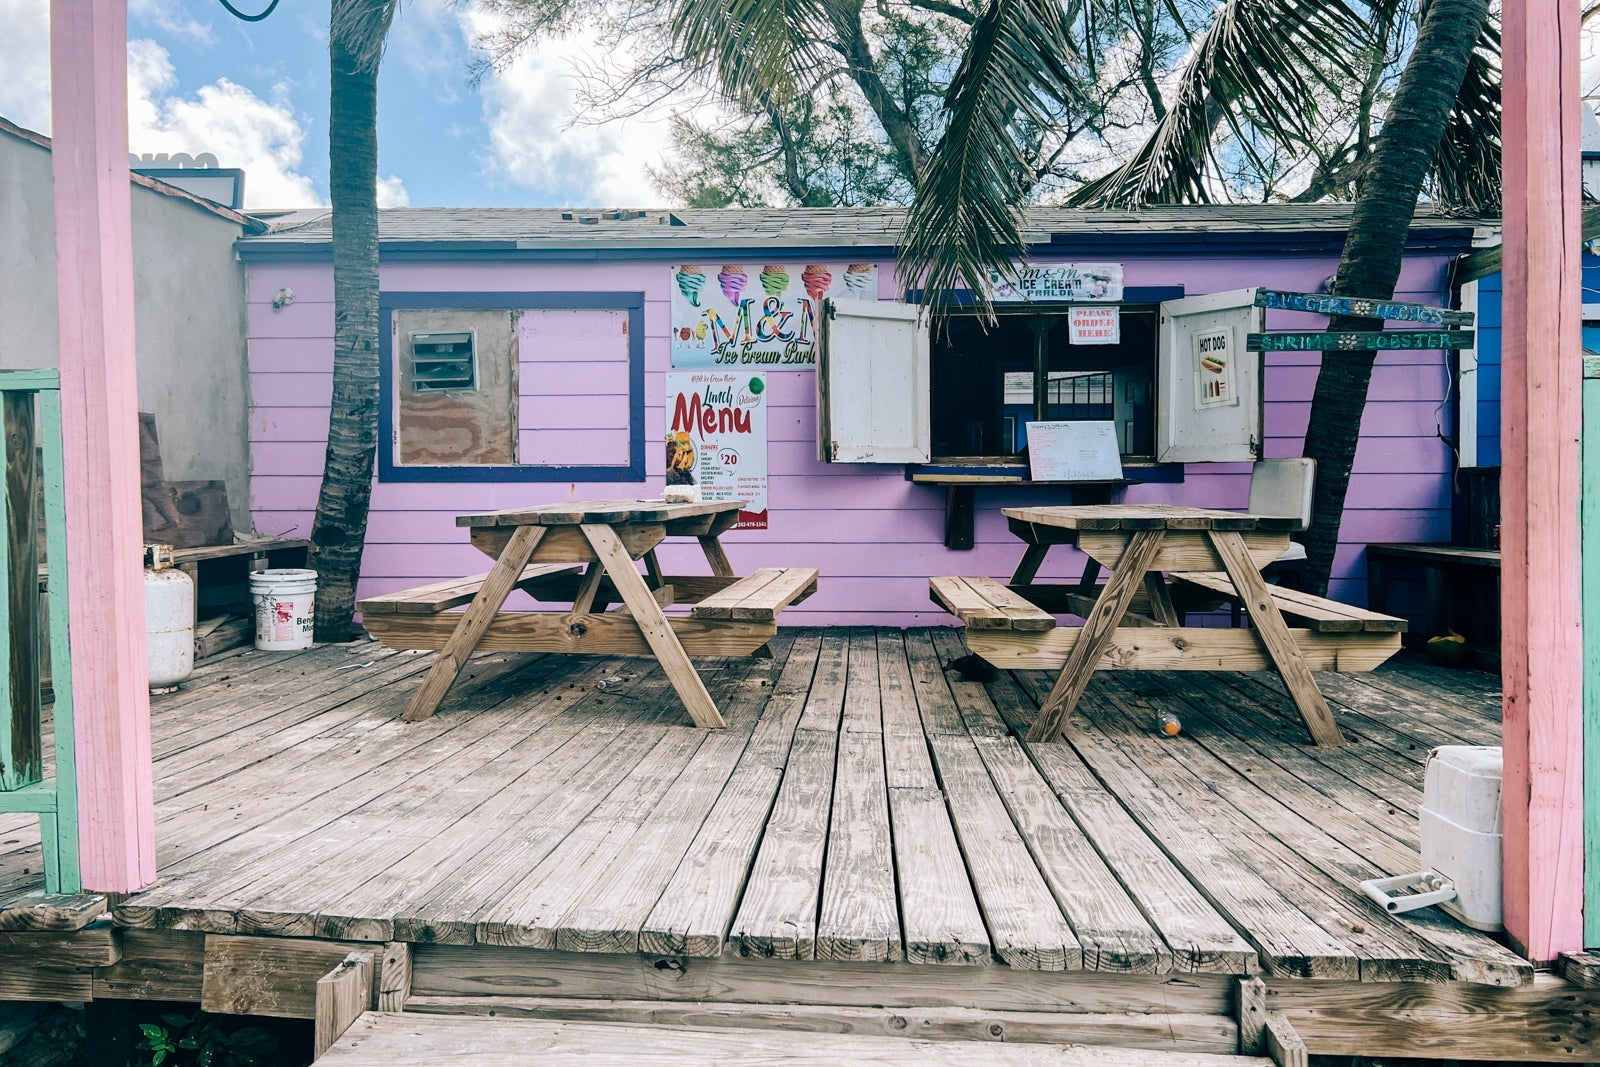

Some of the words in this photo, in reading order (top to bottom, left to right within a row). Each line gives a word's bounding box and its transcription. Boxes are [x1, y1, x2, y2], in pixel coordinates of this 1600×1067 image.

[1020, 280, 1037, 290] ICE
[1044, 279, 1082, 290] CREAM
[1265, 292, 1352, 316] BURGERS
[1375, 304, 1446, 324] NACHOS
[1073, 319, 1115, 328] ORDER
[1078, 330, 1111, 338] HERE
[1260, 334, 1333, 350] SHRIMP
[1365, 333, 1454, 350] LOBSTER
[1199, 337, 1212, 353] HOT
[1212, 335, 1226, 351] DOG
[715, 342, 738, 364] Ice
[740, 342, 781, 364] Cream
[702, 385, 733, 409] Lunch
[671, 392, 751, 442] Menu
[720, 453, 737, 464] $20
